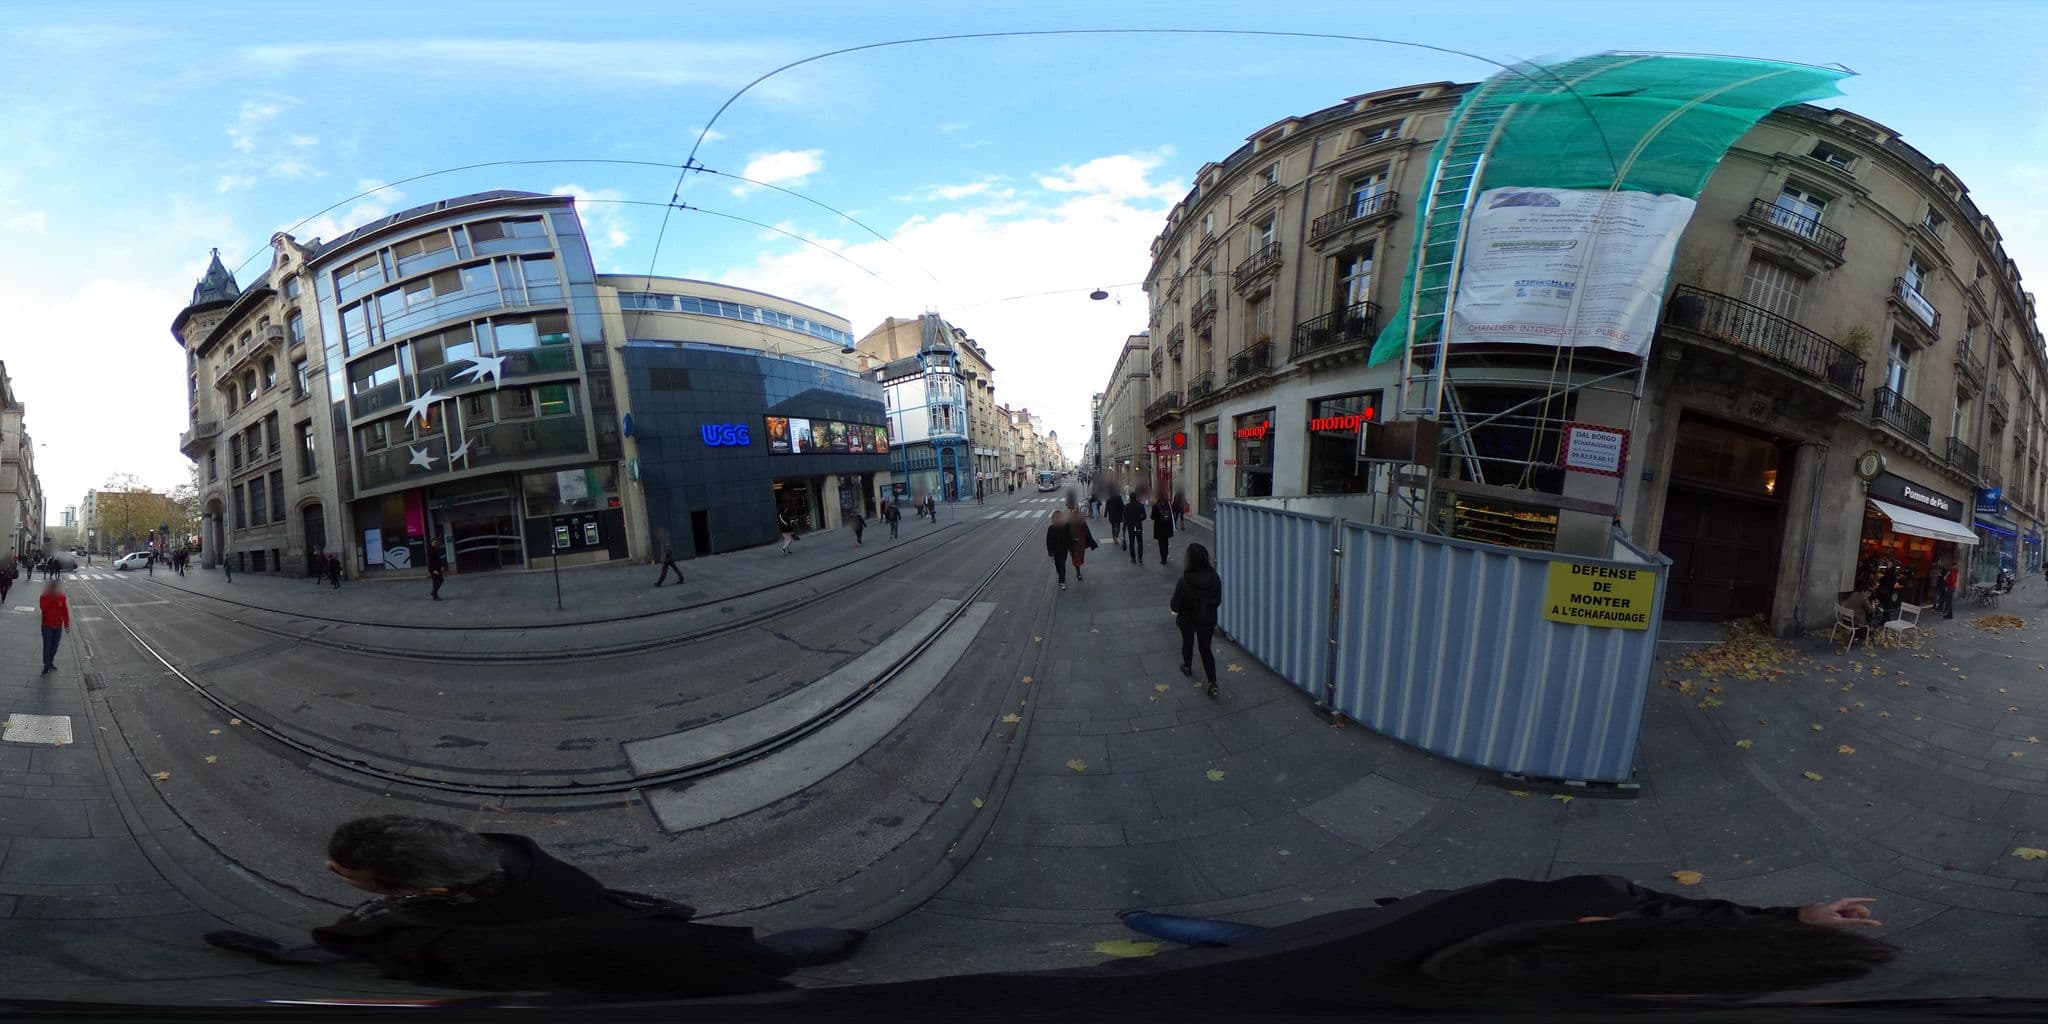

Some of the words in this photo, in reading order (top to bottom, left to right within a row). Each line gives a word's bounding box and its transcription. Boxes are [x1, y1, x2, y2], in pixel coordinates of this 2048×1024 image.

[702, 424, 750, 447] UGC
[1576, 431, 1590, 439] DAL
[1591, 433, 1617, 442] BORGO
[1904, 486, 1930, 504] Pomme
[1572, 564, 1637, 580] DEFENSE
[1593, 581, 1612, 593] DE
[1570, 594, 1631, 608] MONTER
[1552, 605, 1559, 614] A
[1562, 606, 1645, 623] L'ECHAFAUDAGE
